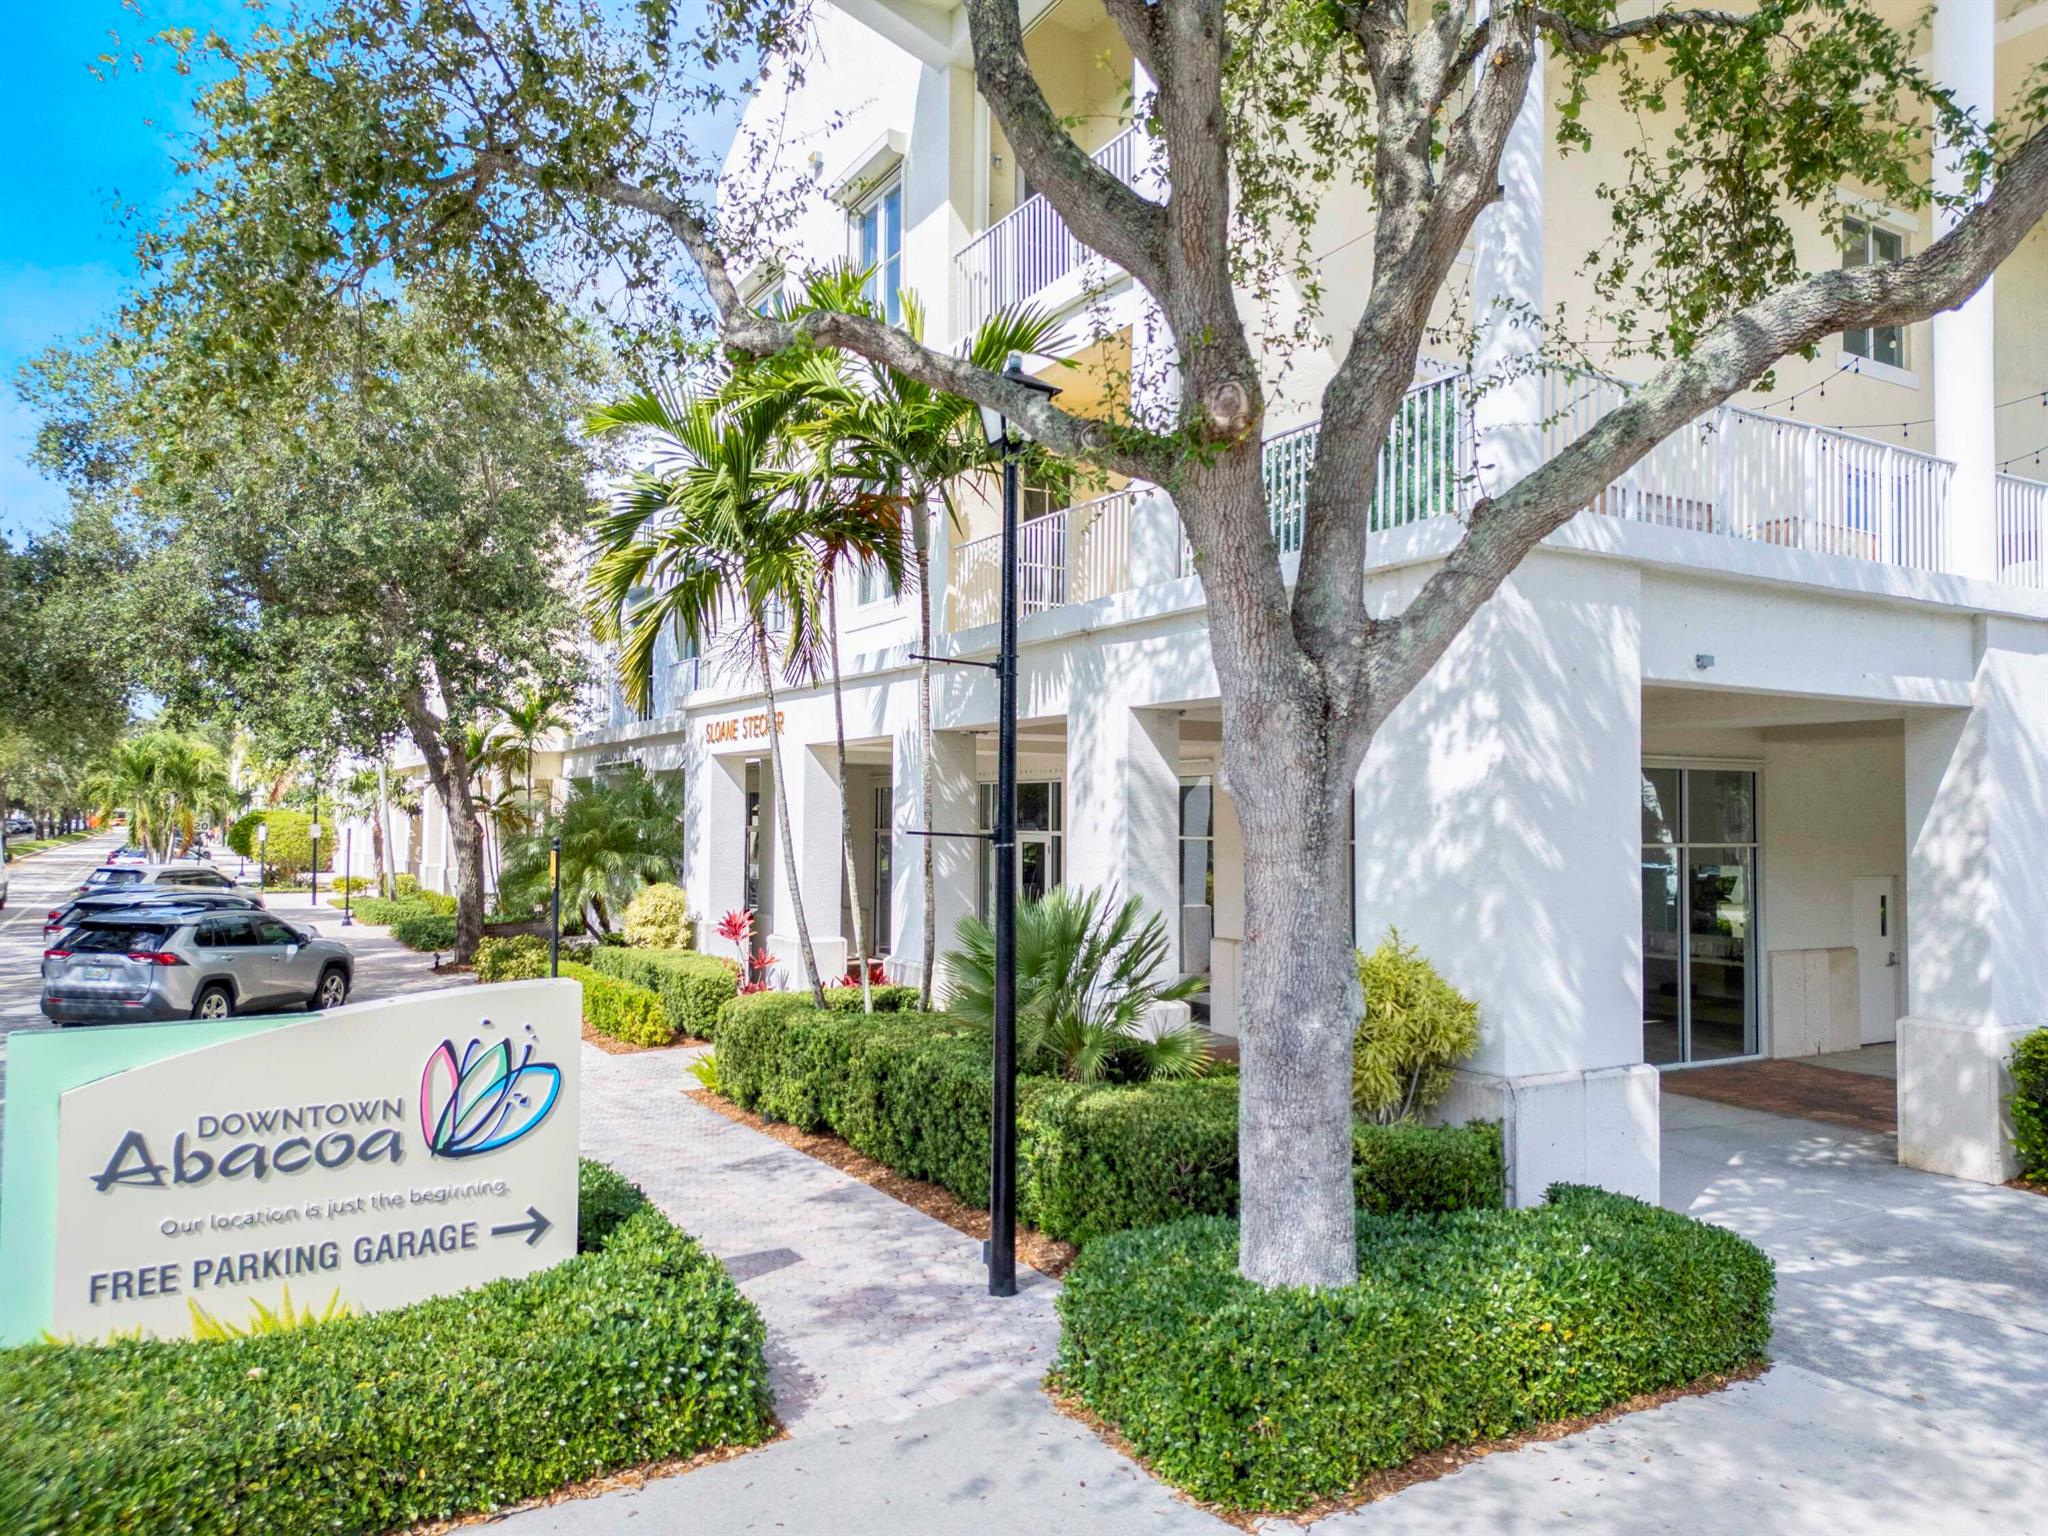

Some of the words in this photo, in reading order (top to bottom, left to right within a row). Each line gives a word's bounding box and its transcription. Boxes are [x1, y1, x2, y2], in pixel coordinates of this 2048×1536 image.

[706, 718, 738, 744] SLOANE
[742, 711, 785, 739] STECR
[198, 1098, 403, 1138] DOWNTOWN
[89, 1128, 403, 1192] Abacoa
[160, 1216, 202, 1236] Our
[210, 1206, 298, 1230] location
[305, 1201, 321, 1218] is
[327, 1197, 368, 1218] just
[371, 1190, 402, 1209] the
[89, 1263, 179, 1304] FREE
[193, 1241, 339, 1288] PARKING
[353, 1221, 478, 1265] GARAGE
